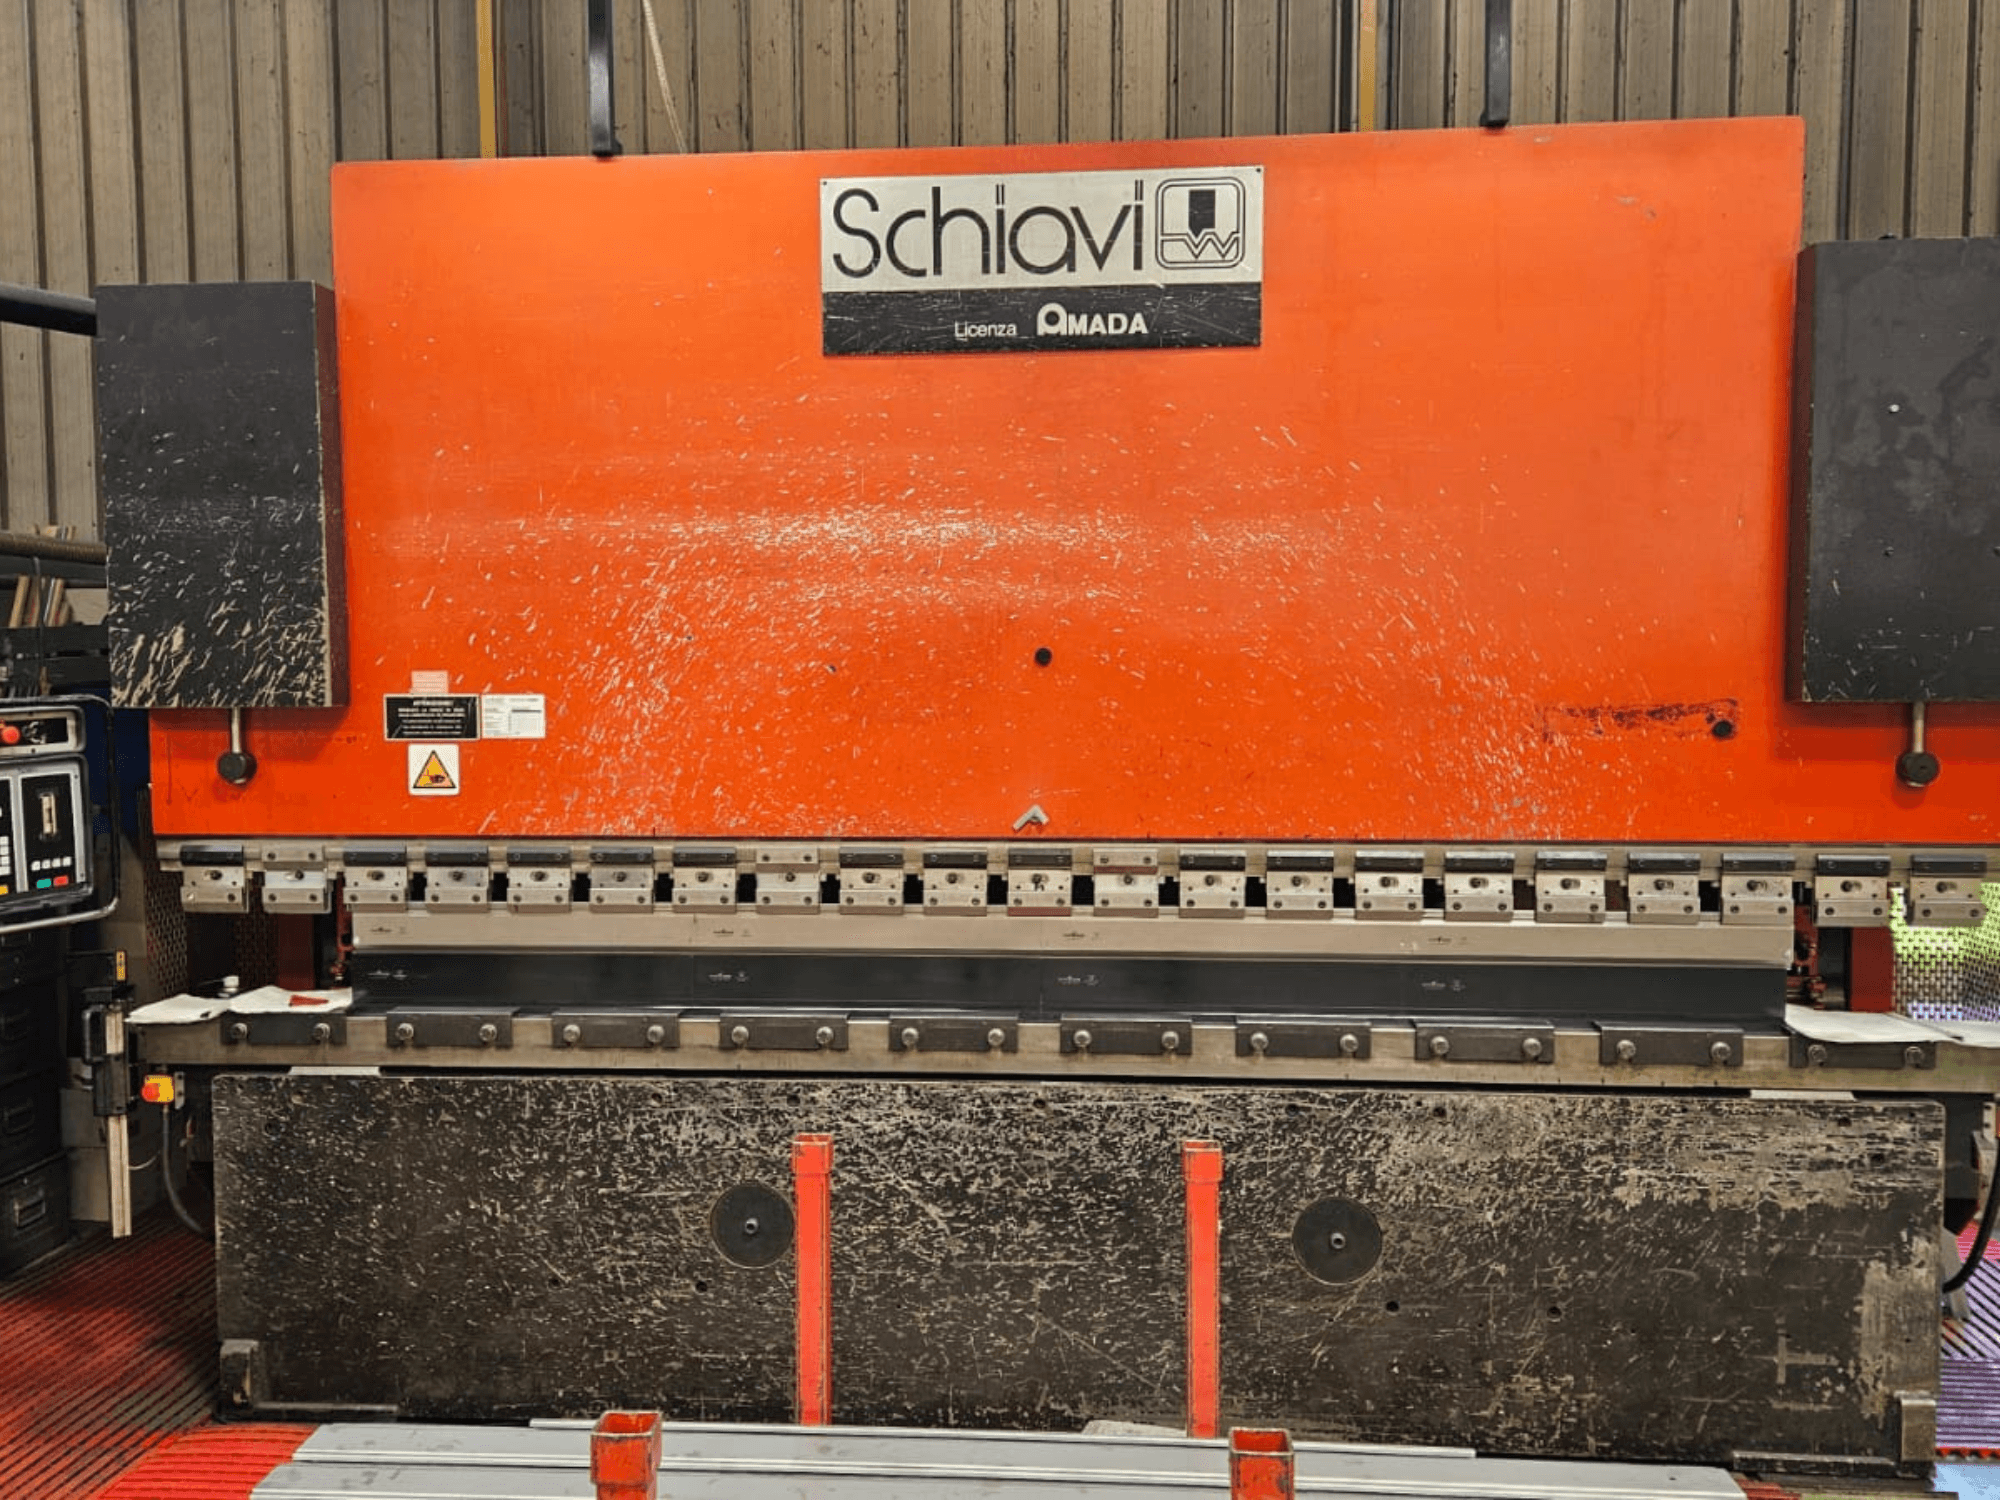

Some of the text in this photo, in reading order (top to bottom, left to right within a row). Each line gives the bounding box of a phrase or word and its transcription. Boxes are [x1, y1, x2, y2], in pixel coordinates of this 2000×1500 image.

[833, 180, 1144, 278] Schiavi
[955, 302, 1148, 338] Licenza AMADA
